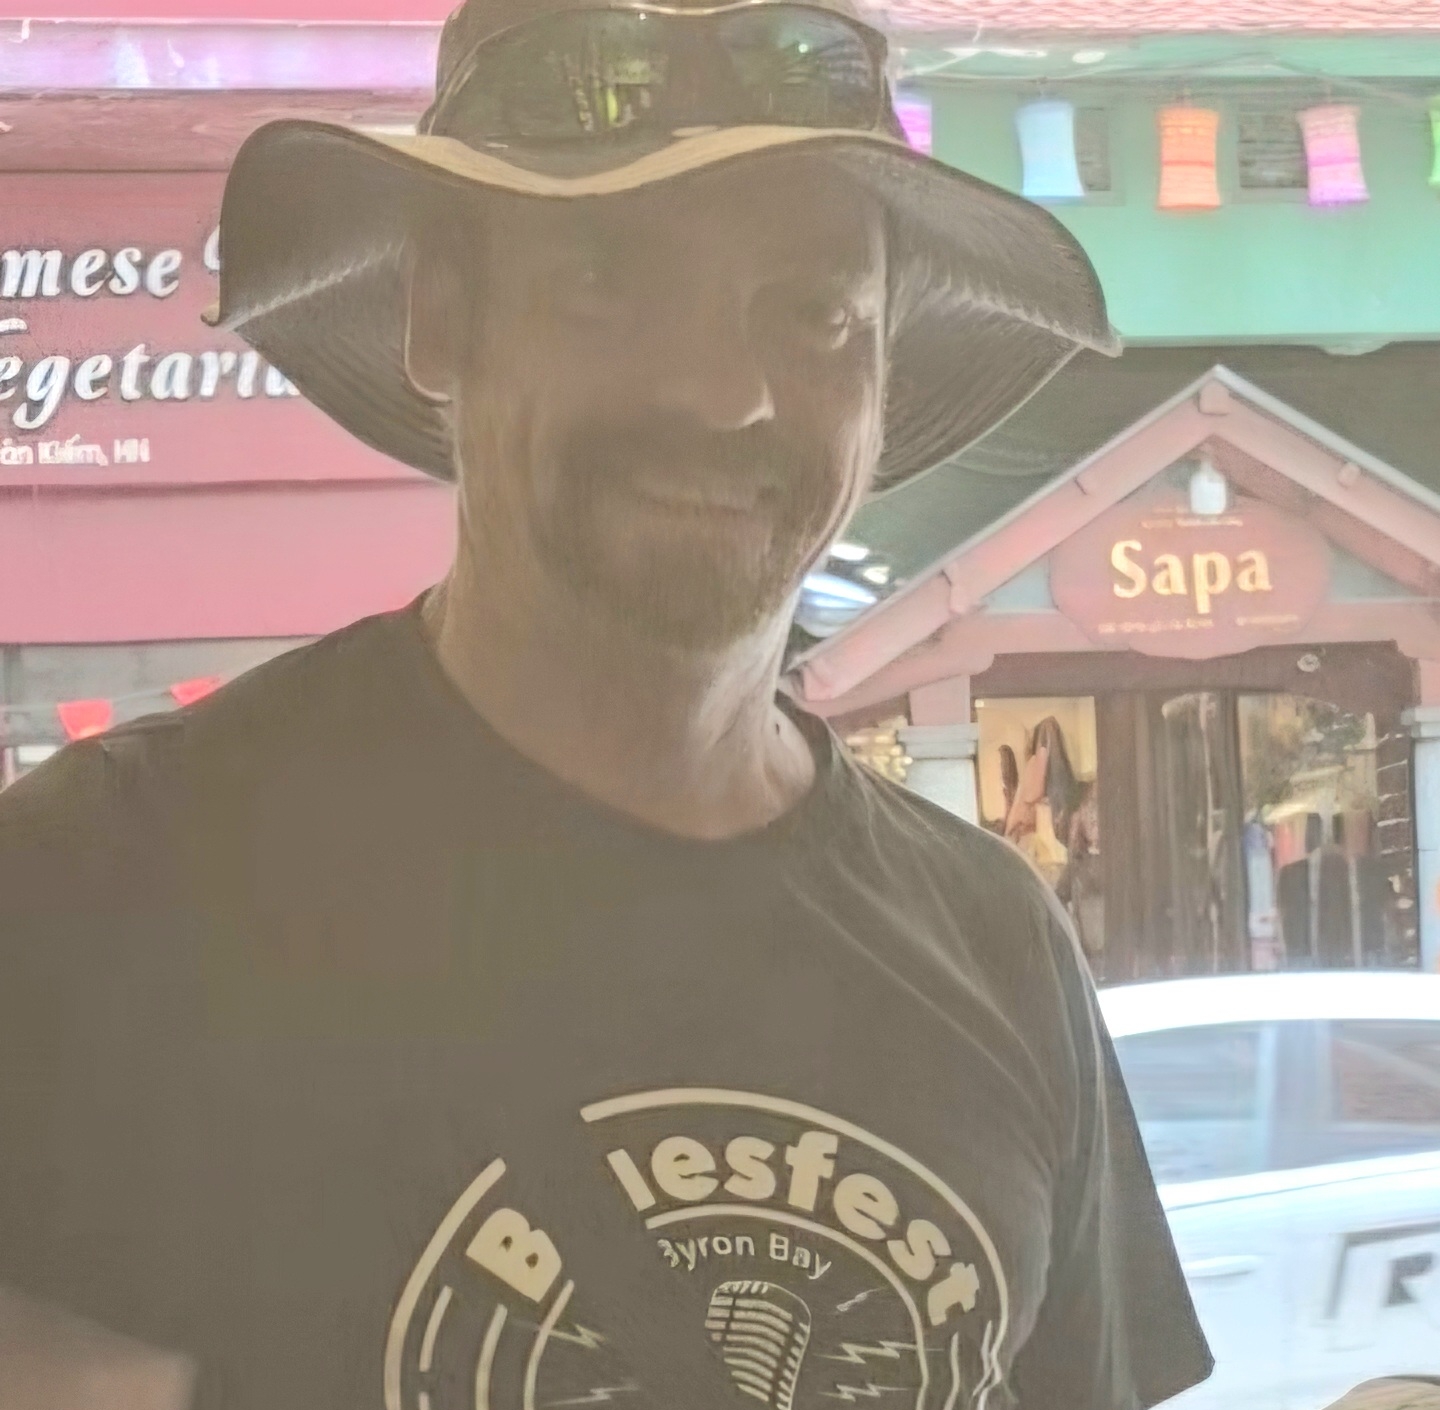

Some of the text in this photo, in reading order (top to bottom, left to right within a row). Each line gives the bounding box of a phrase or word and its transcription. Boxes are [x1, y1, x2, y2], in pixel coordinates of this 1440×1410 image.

[1, 246, 183, 299] mese
[1110, 539, 1273, 614] Sapa
[770, 1232, 832, 1280] Bay
